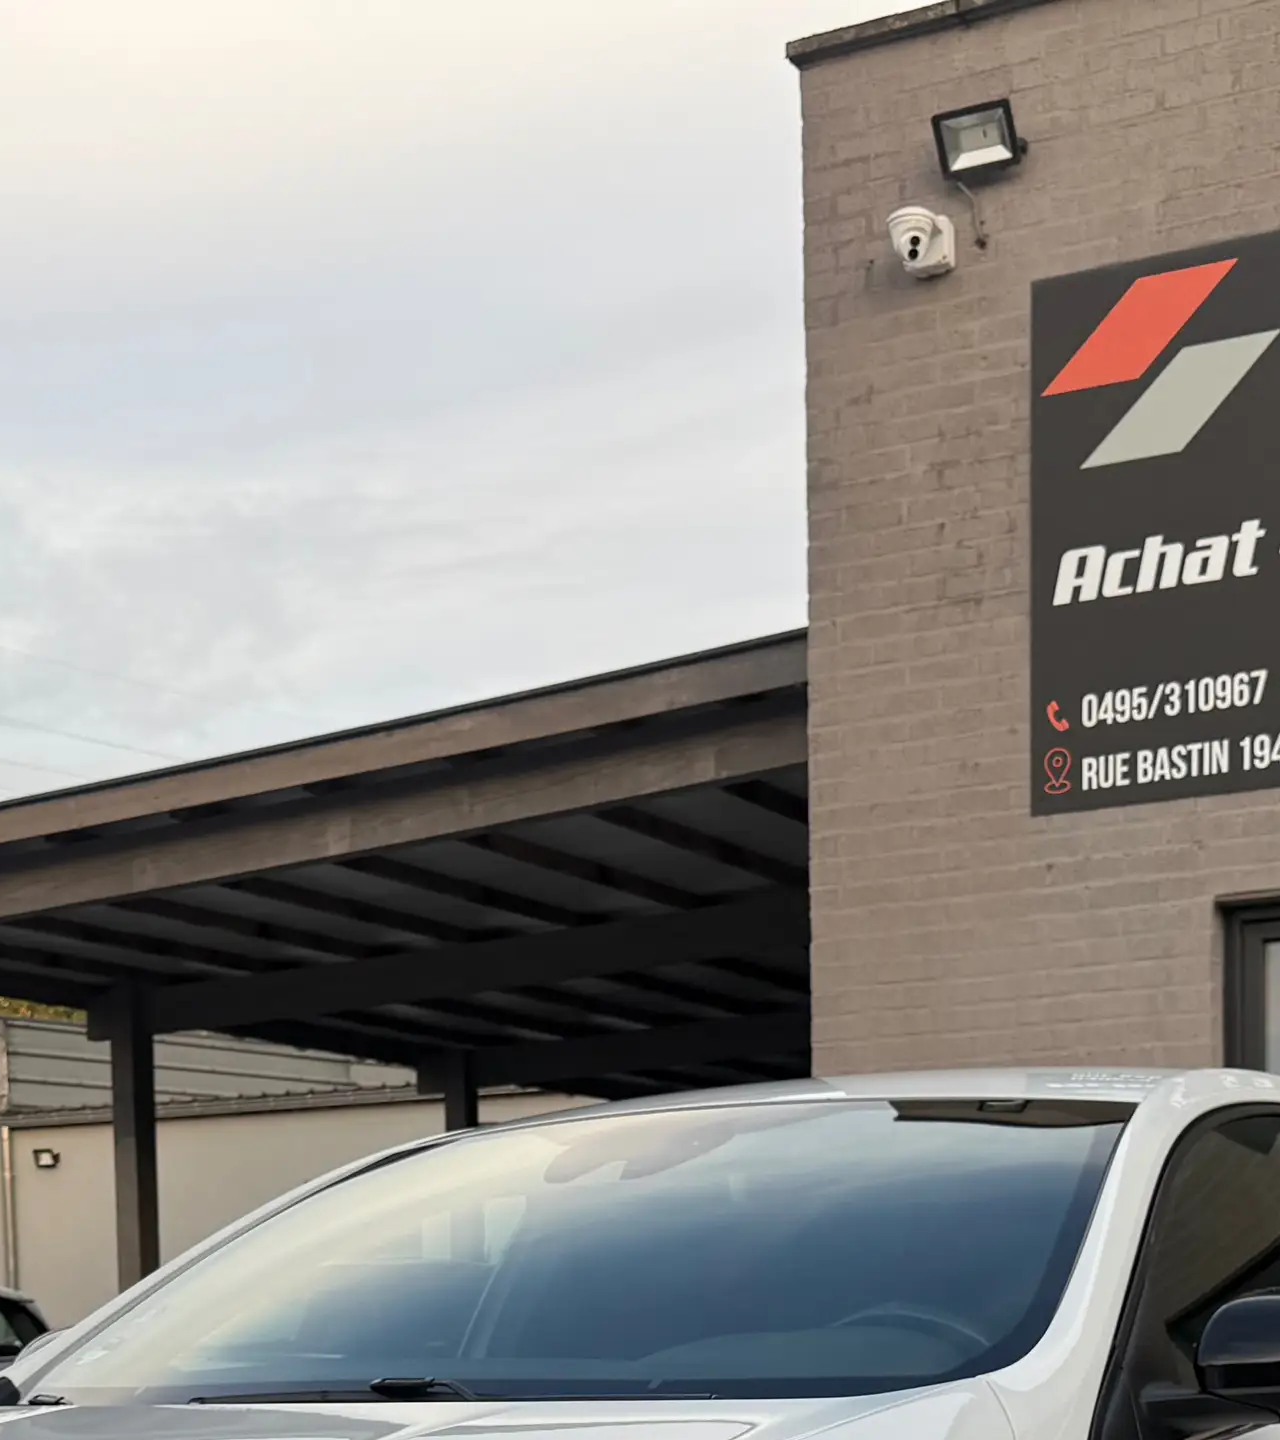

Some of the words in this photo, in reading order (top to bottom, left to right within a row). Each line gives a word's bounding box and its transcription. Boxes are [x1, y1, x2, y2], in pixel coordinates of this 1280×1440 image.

[1052, 518, 1267, 607] Achat
[1081, 668, 1269, 728] 0495/310967
[1081, 751, 1131, 791] RUE
[1136, 738, 1230, 784] BASTIN
